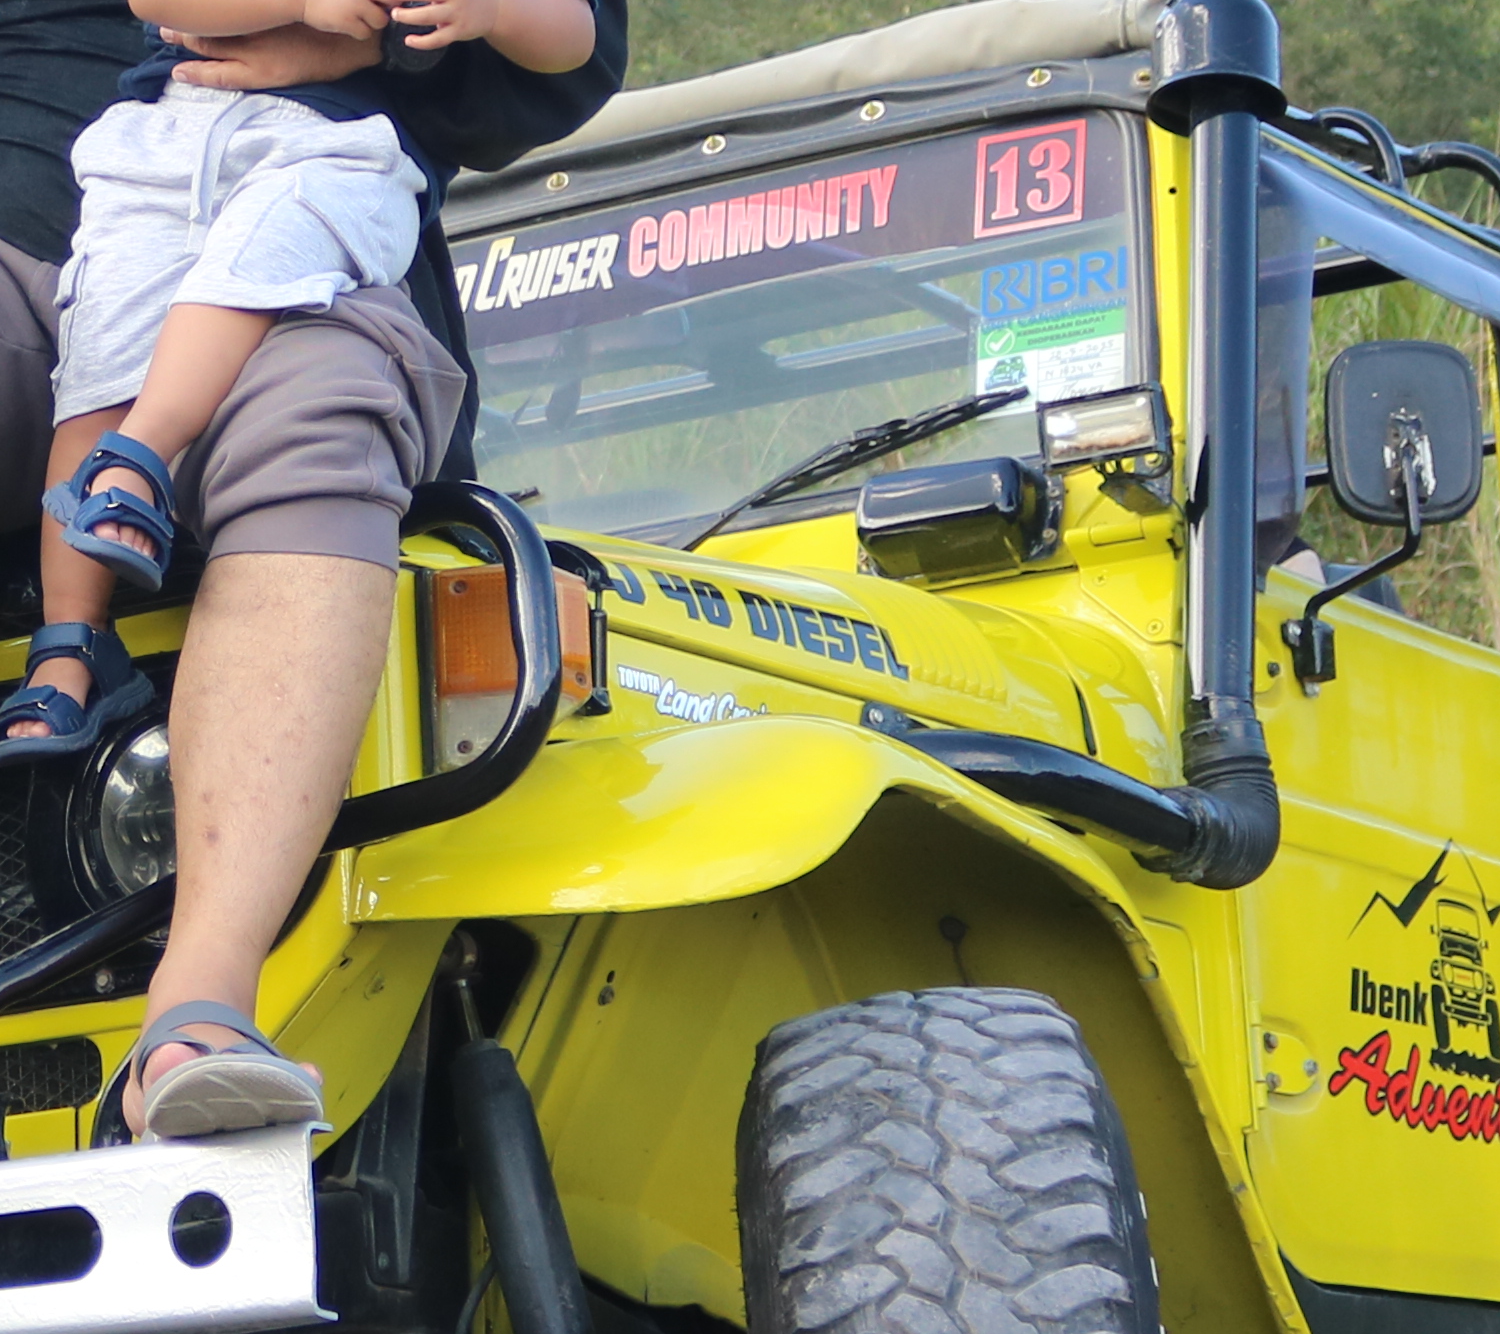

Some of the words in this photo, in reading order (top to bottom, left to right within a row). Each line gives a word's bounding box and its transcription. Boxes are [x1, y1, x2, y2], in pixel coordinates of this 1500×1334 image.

[989, 139, 1073, 223] 13
[474, 233, 621, 313] CRUISER
[628, 164, 898, 279] COMMUNITY
[1041, 245, 1129, 304] BRI
[734, 588, 910, 682] DIESEL
[617, 665, 661, 696] TOYOTA
